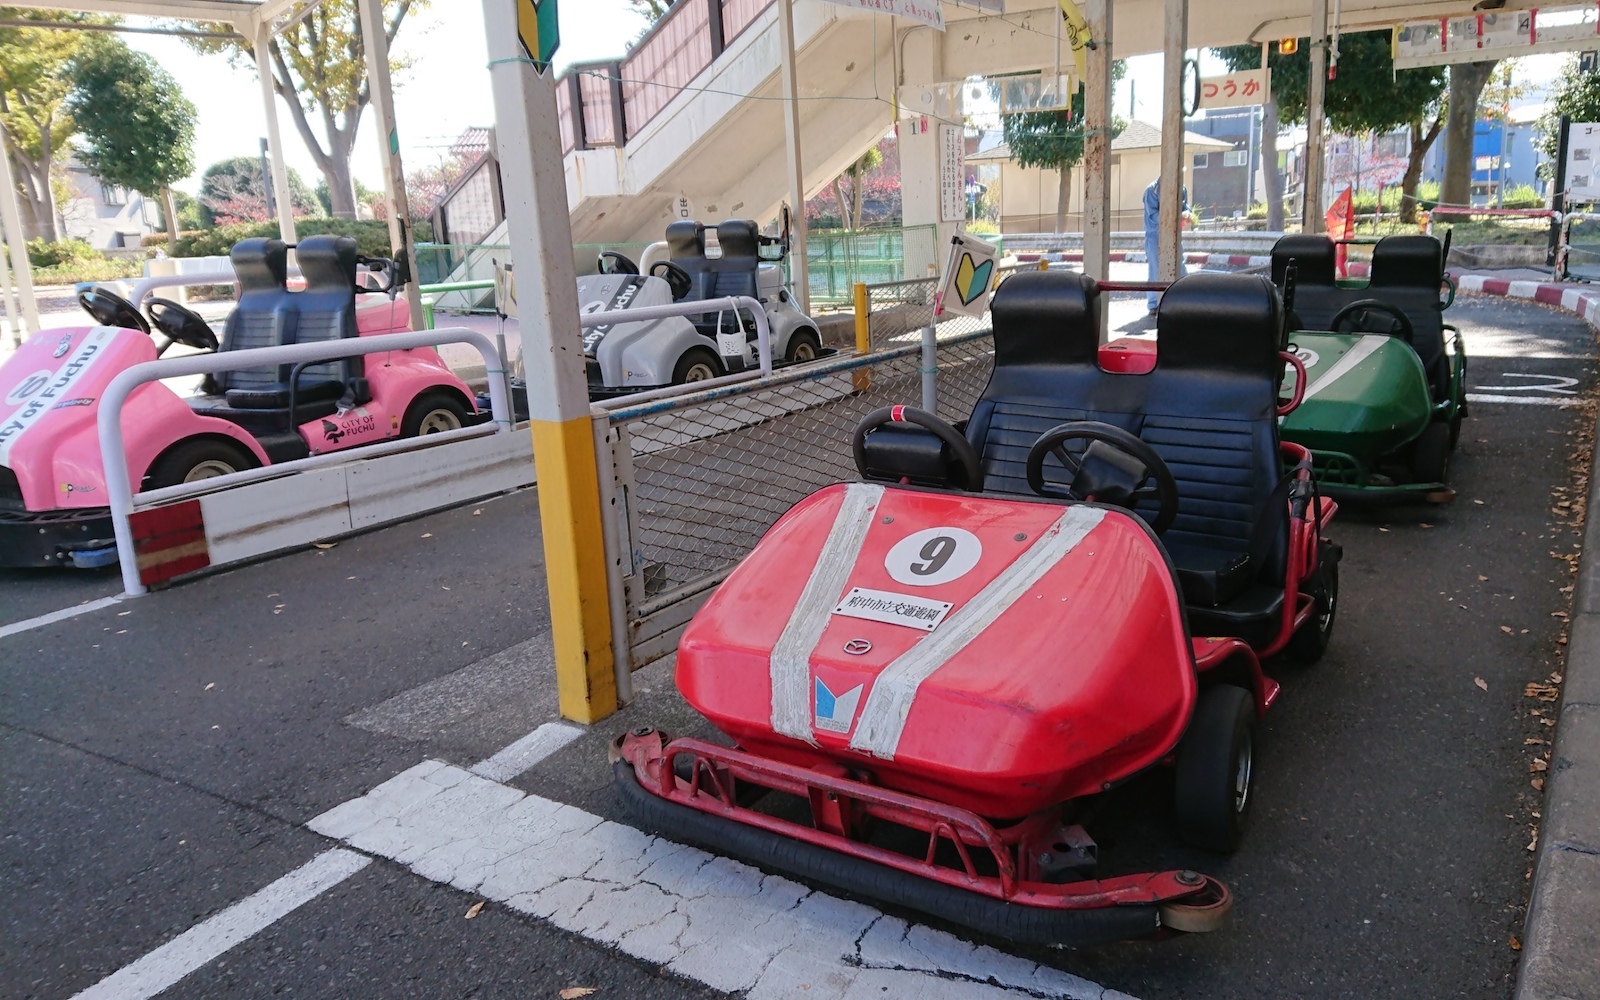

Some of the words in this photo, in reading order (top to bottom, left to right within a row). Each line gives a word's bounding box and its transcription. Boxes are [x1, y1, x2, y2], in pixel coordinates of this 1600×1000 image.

[1203, 79, 1260, 98] つうか
[9, 376, 48, 398] 10
[21, 400, 45, 418] of
[39, 345, 98, 398] Fuchu
[341, 418, 360, 429] CITY
[363, 415, 374, 424] OF
[346, 423, 375, 436] FUCHU
[910, 536, 957, 576] 9
